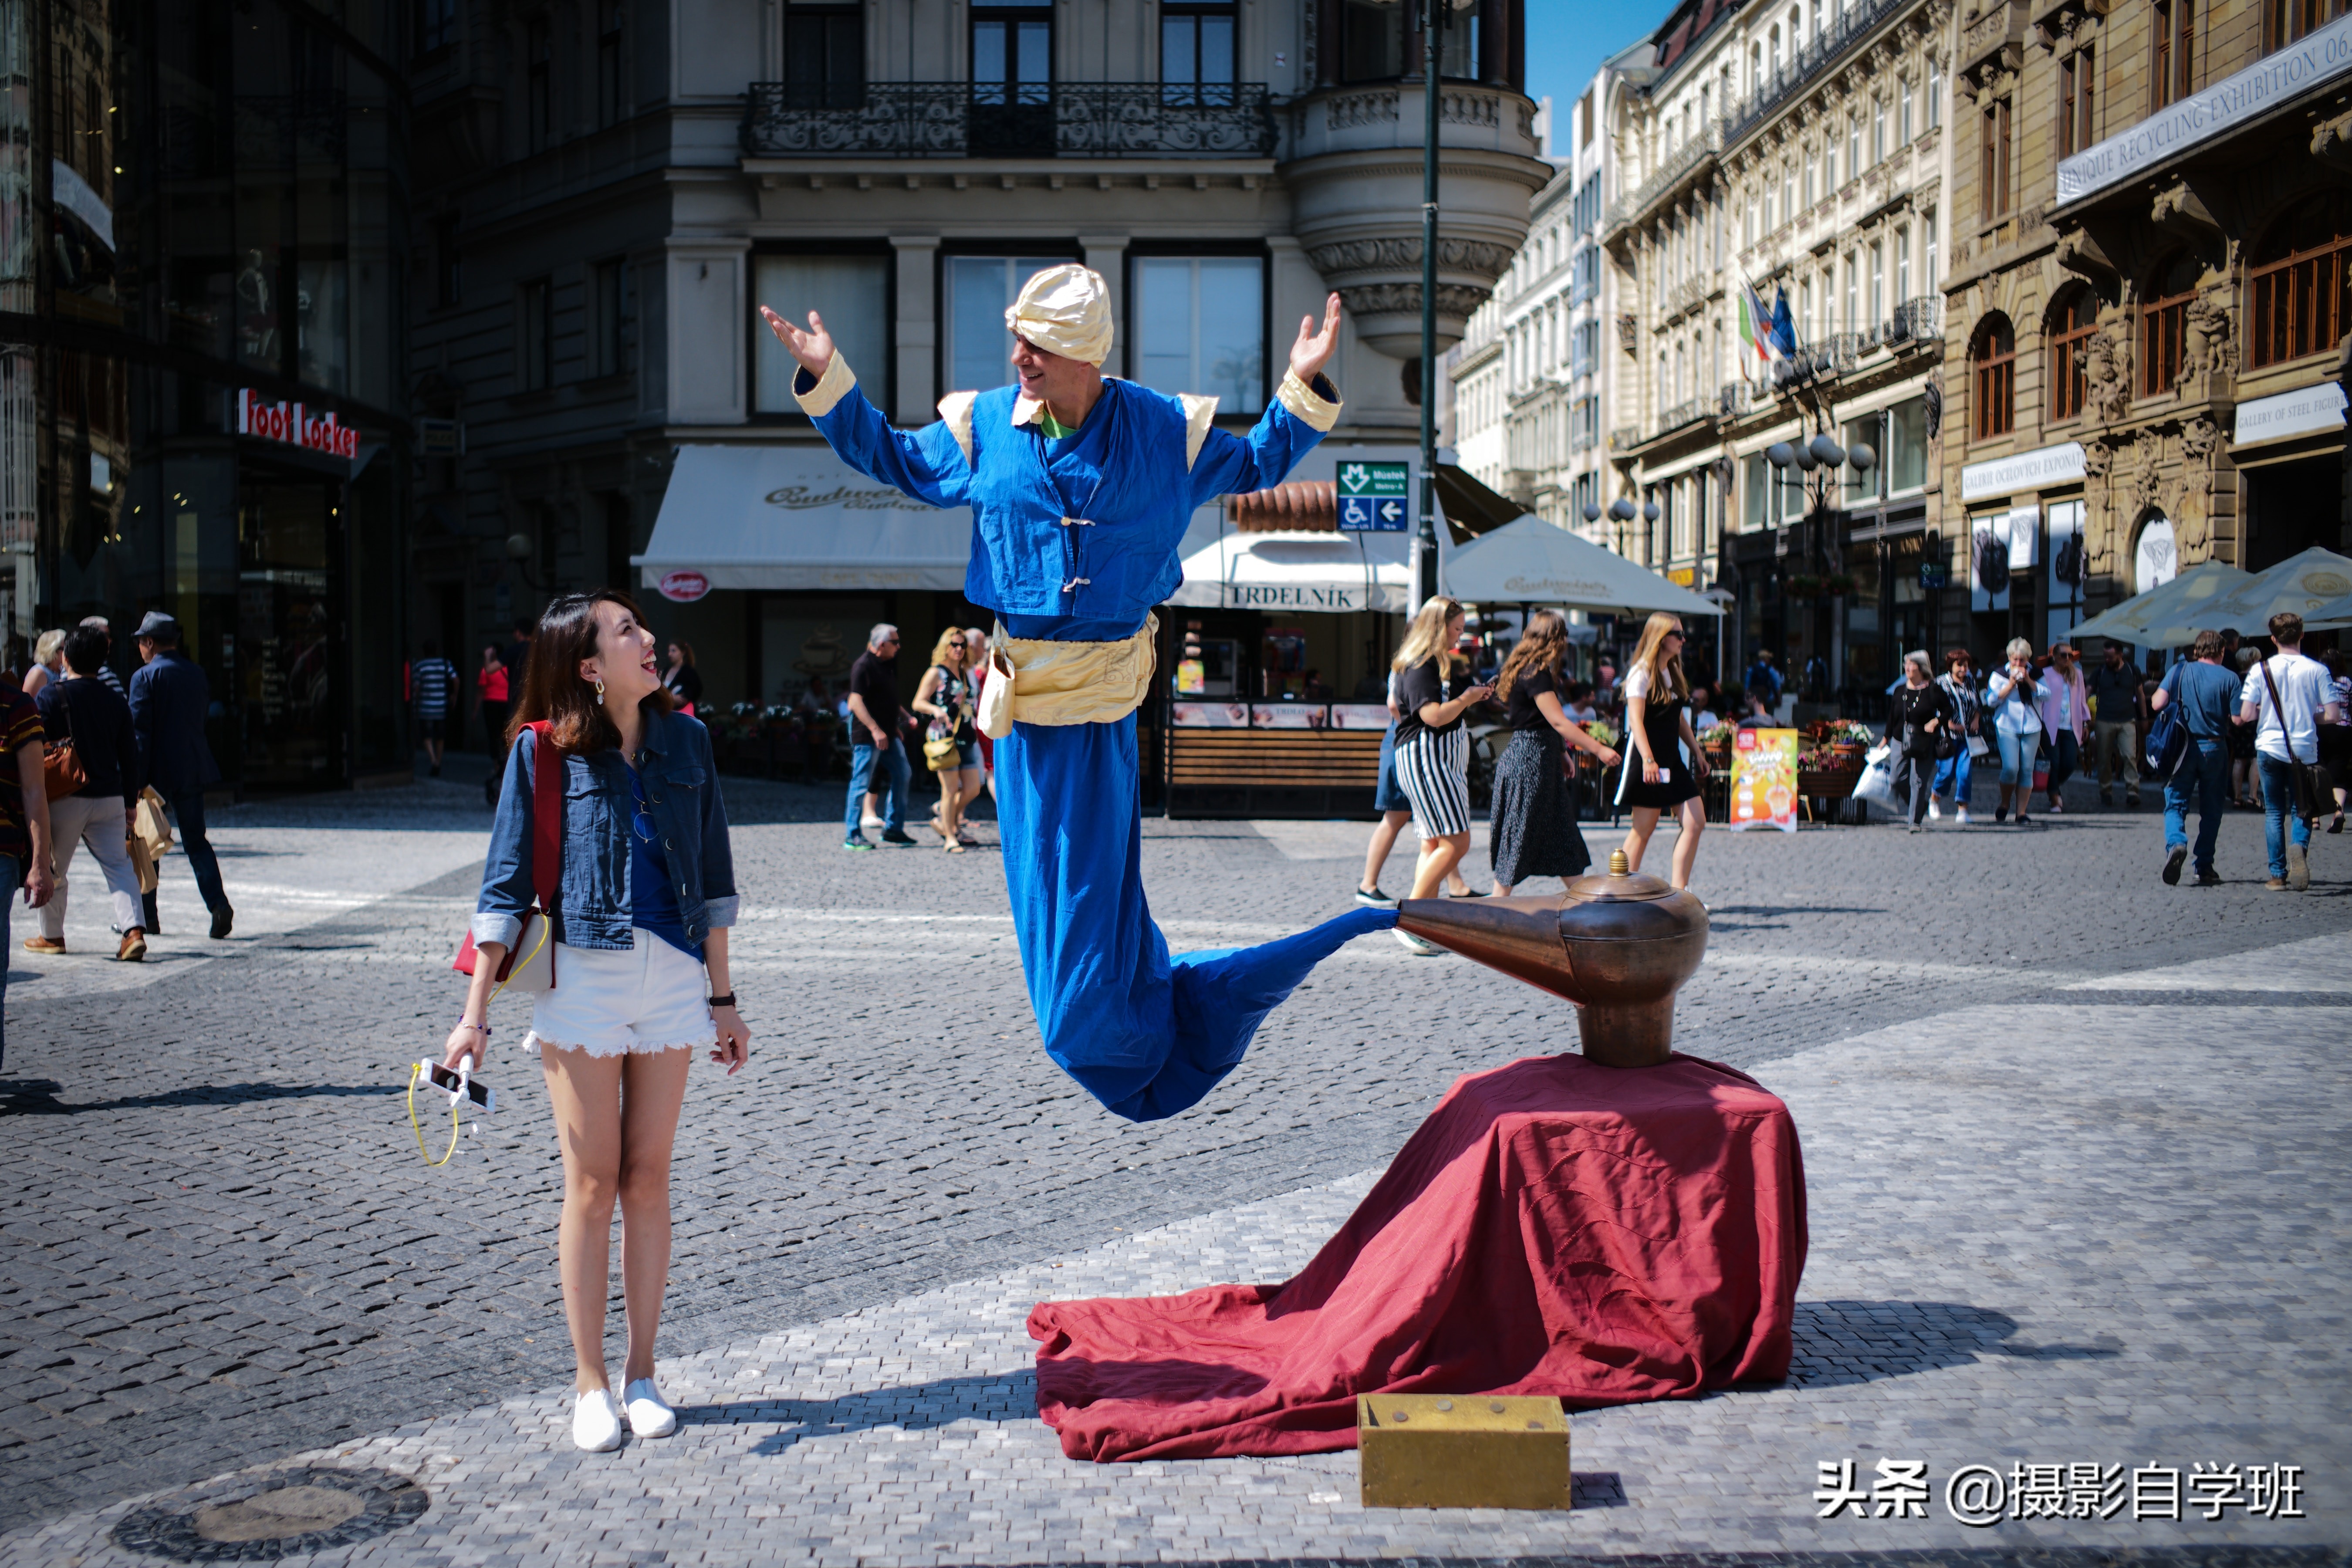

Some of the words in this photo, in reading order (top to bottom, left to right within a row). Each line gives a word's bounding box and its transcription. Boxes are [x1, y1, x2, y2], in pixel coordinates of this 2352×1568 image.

[2063, 149, 2113, 192] UNIQUE
[2119, 106, 2203, 166] RECYCLING
[2211, 47, 2316, 121] EXHIBITION
[239, 388, 293, 443] Foot
[293, 402, 360, 460] Locker
[2238, 411, 2272, 429] GALLERY
[2275, 407, 2286, 421] OF
[2288, 402, 2311, 418] STEEL
[2314, 393, 2349, 412] FIGURE
[1965, 470, 1994, 491] GALERIE
[2044, 450, 2084, 474] EXPONÁT
[1230, 584, 1353, 607] TRDELNÍK
